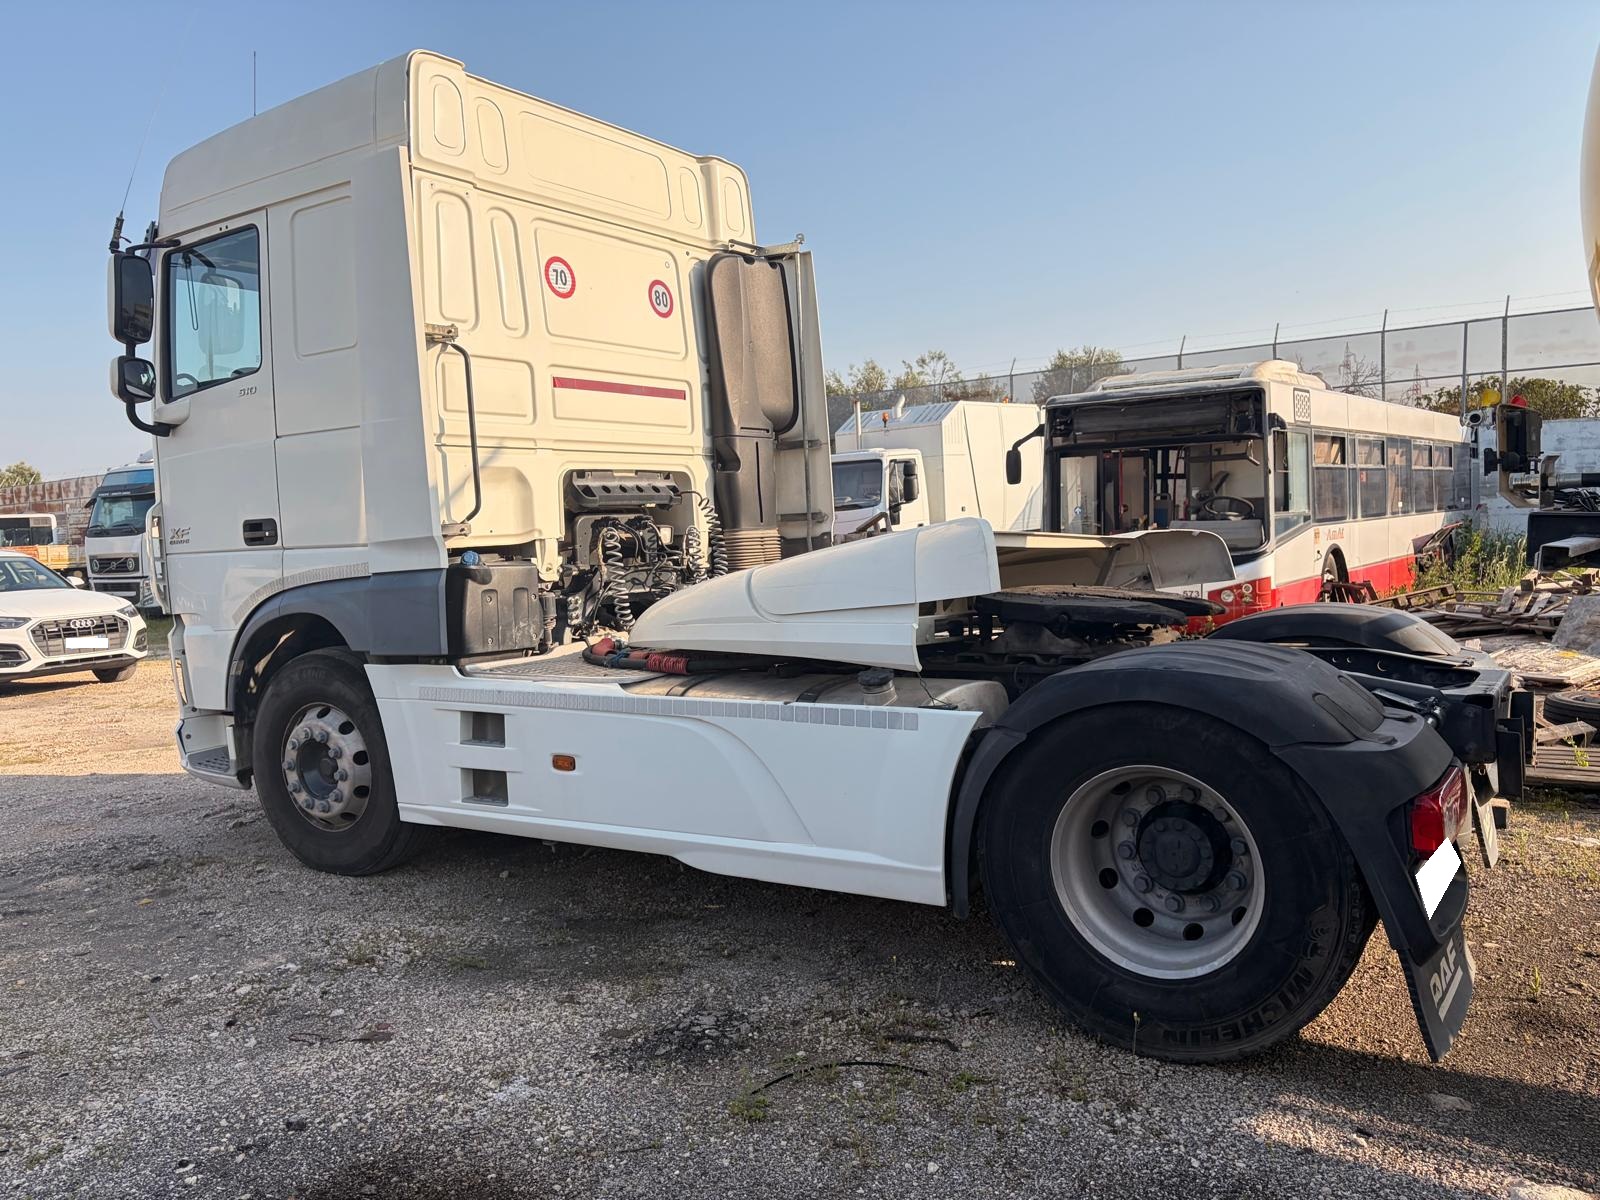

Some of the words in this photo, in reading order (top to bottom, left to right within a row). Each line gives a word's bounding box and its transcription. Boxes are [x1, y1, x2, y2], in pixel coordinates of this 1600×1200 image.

[552, 268, 568, 286] 70
[654, 289, 669, 308] 80
[1183, 590, 1200, 599] 573
[1429, 937, 1457, 1008] DAF
[1162, 966, 1314, 1046] MICHELIN
